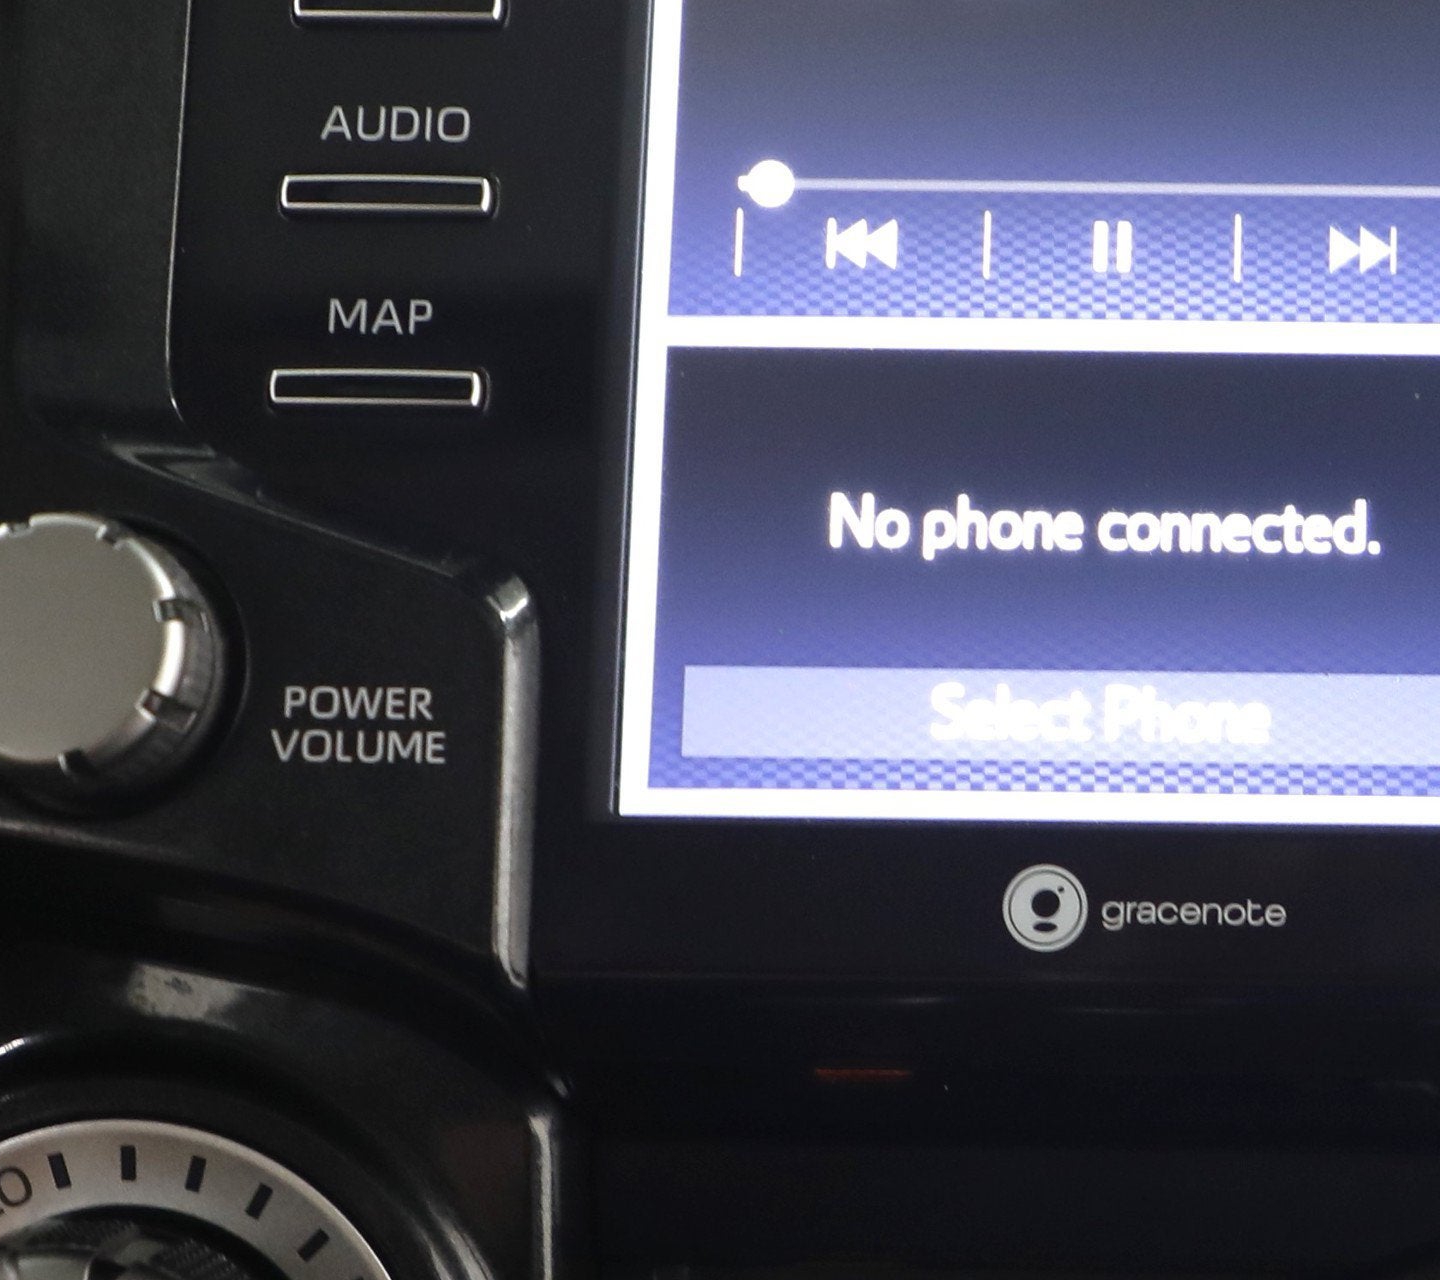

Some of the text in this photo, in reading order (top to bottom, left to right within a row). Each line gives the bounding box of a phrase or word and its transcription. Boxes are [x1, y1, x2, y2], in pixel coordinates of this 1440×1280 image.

[319, 104, 472, 144] AUDIO
[327, 298, 434, 335] MAP
[826, 491, 1383, 562] No phone connected.
[283, 685, 434, 721] POWER
[929, 681, 1273, 745] Select Phone
[270, 728, 447, 765] VOLUME
[1100, 898, 1288, 932] gracenote
